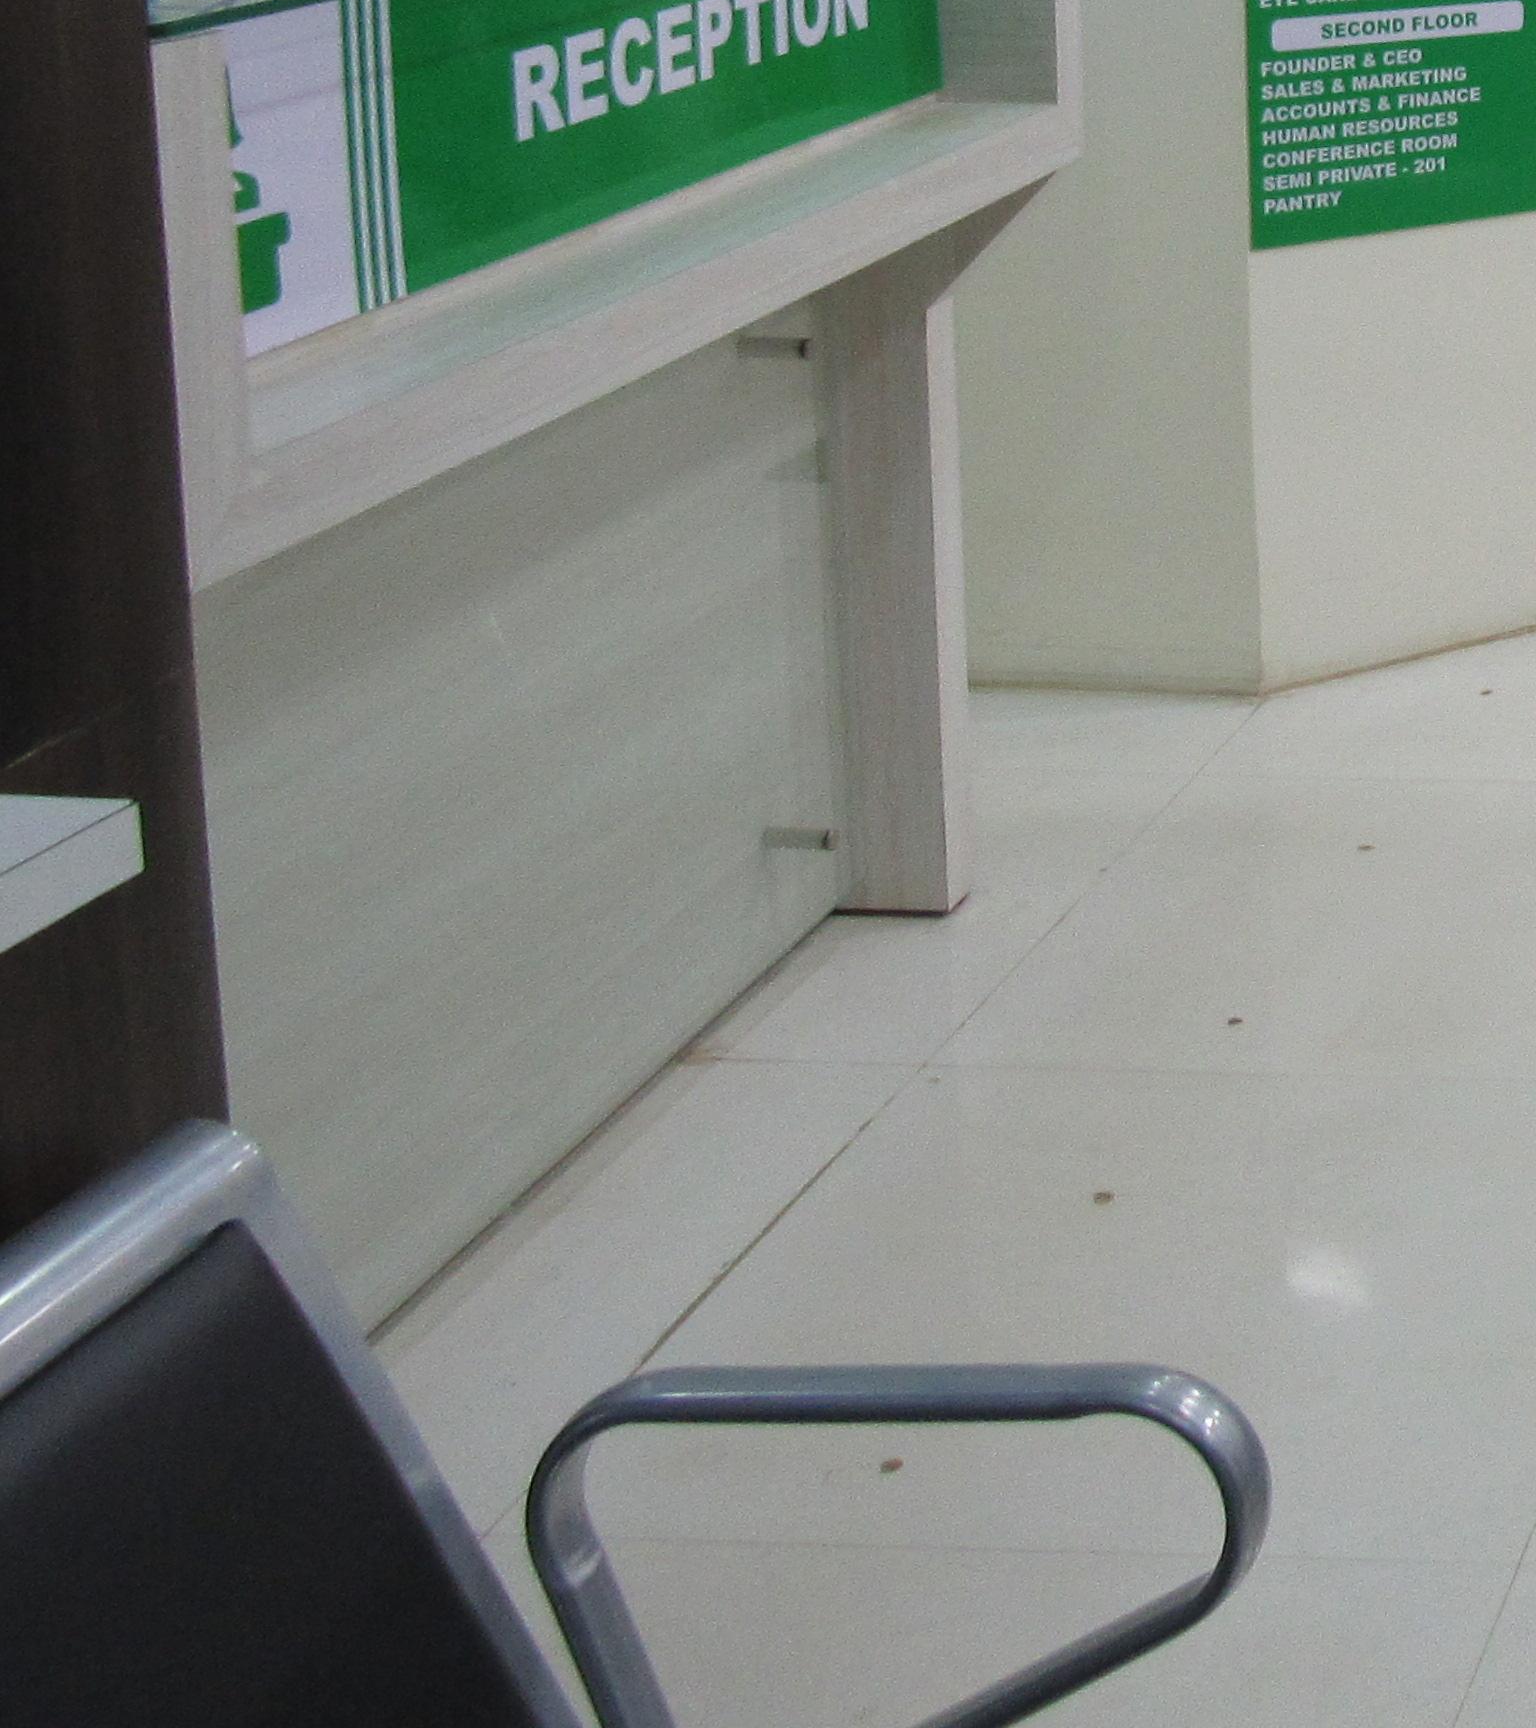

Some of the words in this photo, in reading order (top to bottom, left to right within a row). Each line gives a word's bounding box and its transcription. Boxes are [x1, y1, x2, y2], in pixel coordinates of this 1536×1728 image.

[1321, 19, 1405, 40] SECOND
[1412, 12, 1477, 31] FLOOR
[1262, 56, 1355, 77] FOUNDER
[1363, 54, 1376, 69] &
[1383, 48, 1422, 65] CEO
[1262, 81, 1324, 101] SALES
[1332, 78, 1344, 93] &
[1352, 67, 1467, 89] MARKETING
[1262, 99, 1370, 123] ACCOUNTS
[1378, 96, 1390, 110] &
[1399, 87, 1481, 108] FINANCE
[1262, 124, 1335, 145] HUMAN
[1343, 112, 1458, 134] RESOURCES
[1263, 141, 1395, 169] CONFERENCE
[1402, 133, 1457, 154] ROOM
[1263, 172, 1312, 192] SEMI
[1319, 163, 1397, 185] PRIVATE
[1414, 157, 1446, 173] 201
[1263, 191, 1342, 215] PANTRY
